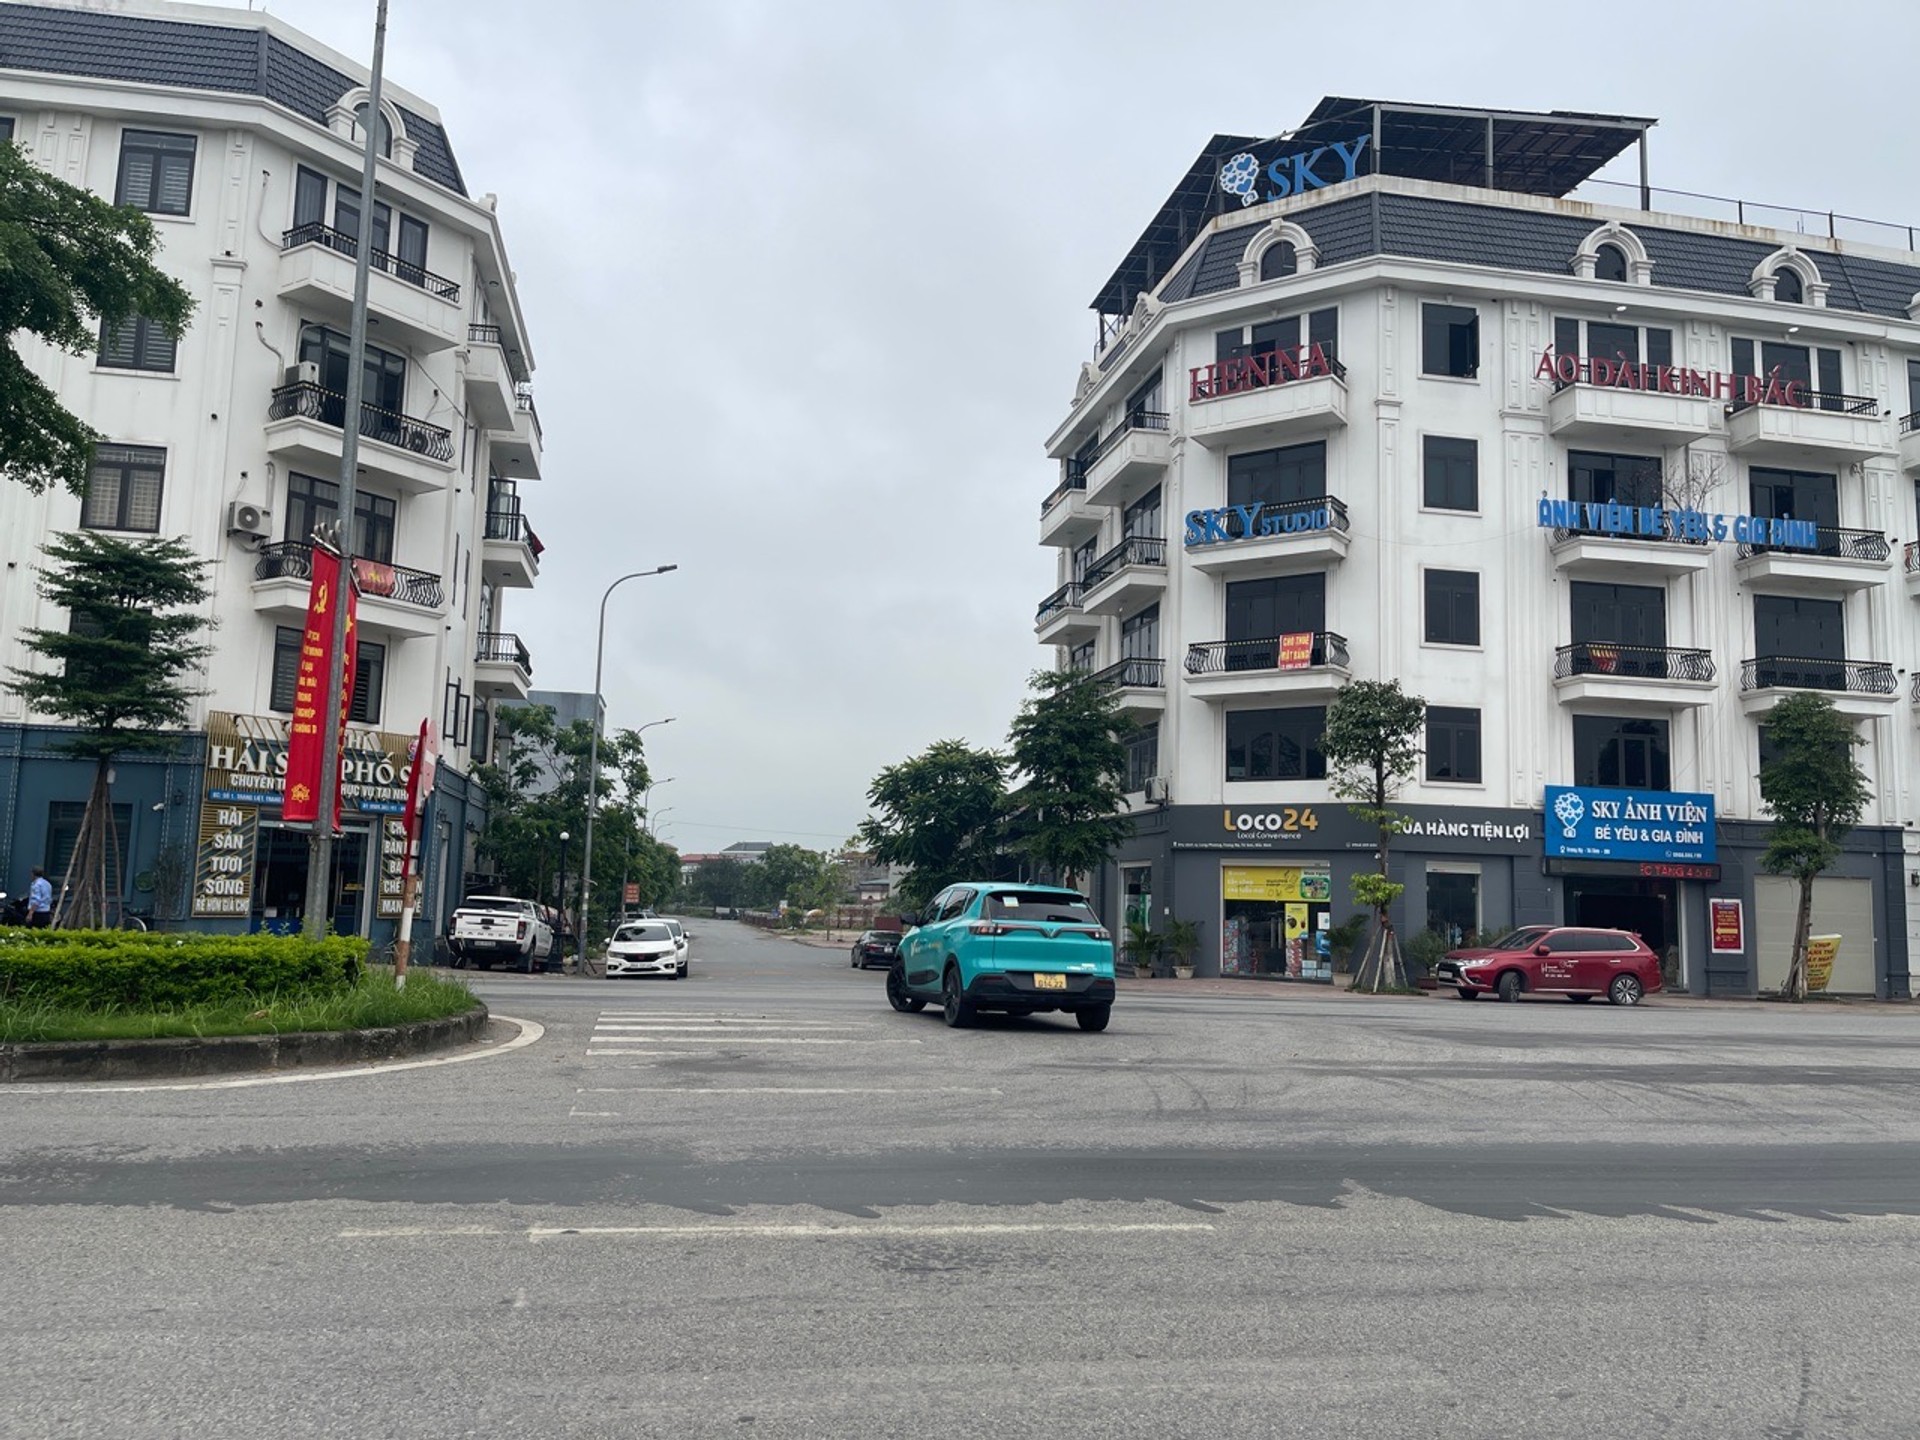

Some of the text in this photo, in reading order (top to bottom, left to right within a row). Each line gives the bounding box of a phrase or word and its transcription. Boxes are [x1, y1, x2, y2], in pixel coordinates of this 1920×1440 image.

[1267, 133, 1372, 202] SKY
[1189, 341, 1331, 402] HENNA
[1535, 343, 1580, 383] ÁO
[1657, 364, 1737, 400] KINH
[1745, 361, 1807, 408] BẮC
[1184, 501, 1329, 547] SKY STUDIO
[1586, 497, 1636, 539] VIỆN
[1712, 513, 1728, 542] &
[1733, 515, 1767, 545] GIA
[1771, 513, 1817, 549] ĐÌNH
[209, 740, 270, 774] HẢI
[341, 752, 395, 785] PHỐ
[230, 774, 275, 789] CHUYÊN
[341, 783, 360, 798] HỤC
[392, 788, 409, 801] NH
[218, 806, 243, 826] HẢI
[1592, 796, 1708, 828] SKY ẢNH VIỆN
[213, 829, 245, 849] SẢN
[1237, 831, 1302, 840] Local Convenience
[1426, 818, 1468, 837] HÀNG
[1470, 821, 1503, 842] TIỆN
[1505, 823, 1530, 843] LỢI
[1594, 824, 1704, 845] BÉ YÊU & GIA ĐÌNH
[211, 856, 243, 873] TƯƠI
[205, 875, 244, 895] SỐNG
